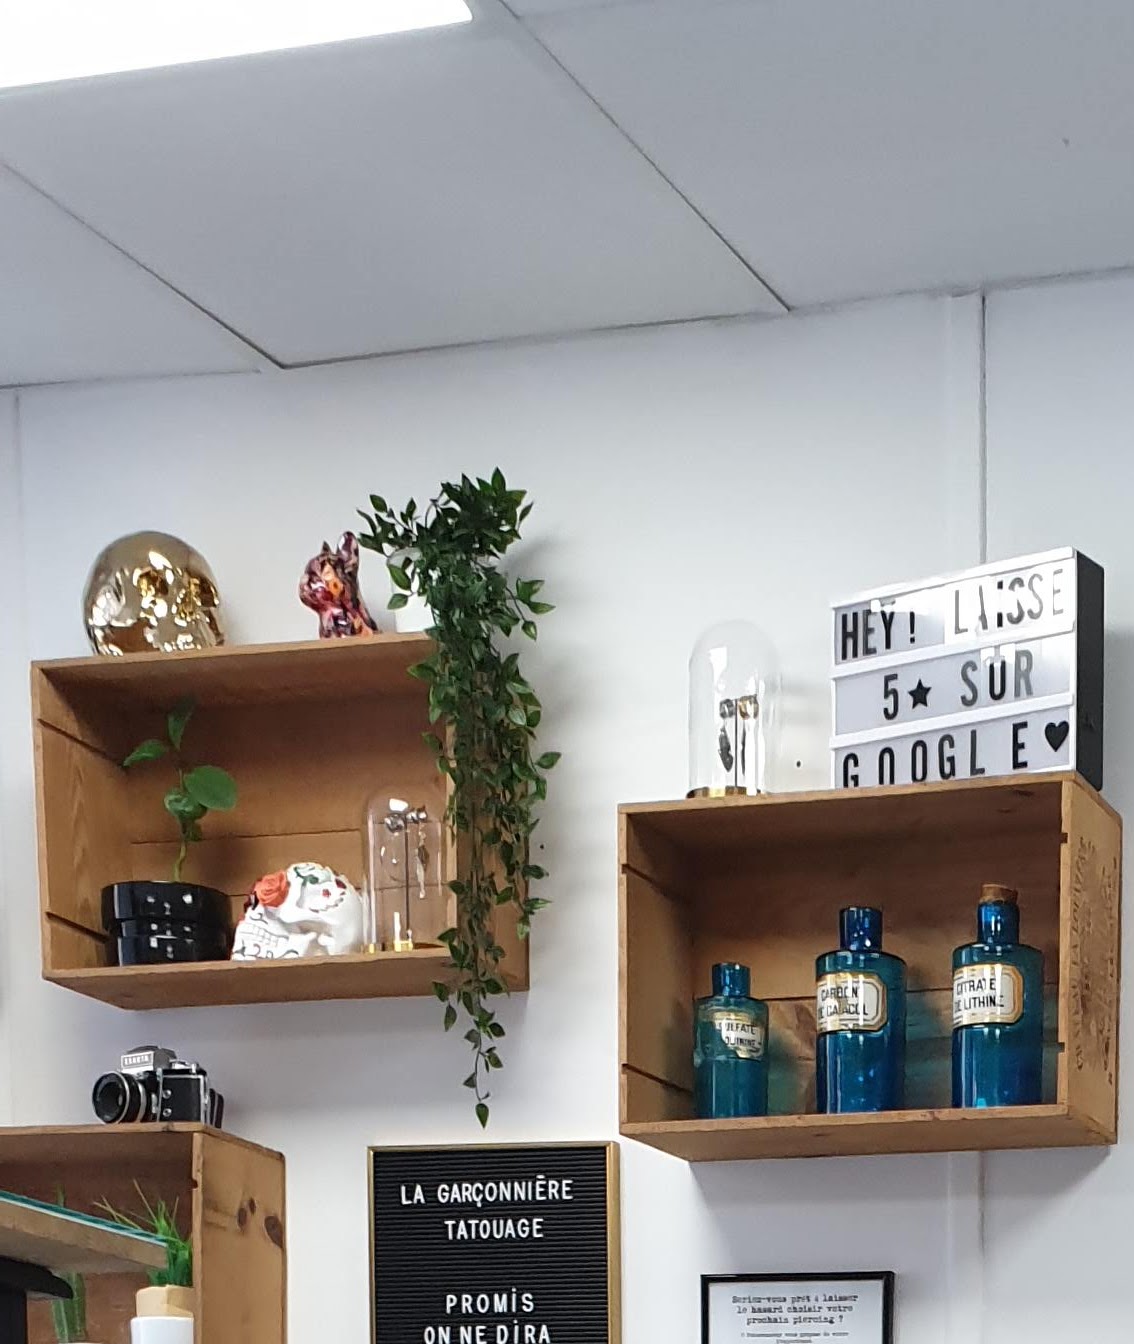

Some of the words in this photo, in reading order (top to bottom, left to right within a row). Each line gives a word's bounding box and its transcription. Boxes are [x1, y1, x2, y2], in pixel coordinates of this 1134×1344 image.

[960, 649, 1033, 707] SUR
[842, 720, 1029, 789] GOOGLE
[400, 1182, 425, 1206] LA
[444, 1217, 544, 1240] TATOUAGE
[746, 1316, 789, 1325] prochain
[793, 1315, 835, 1325] piercing
